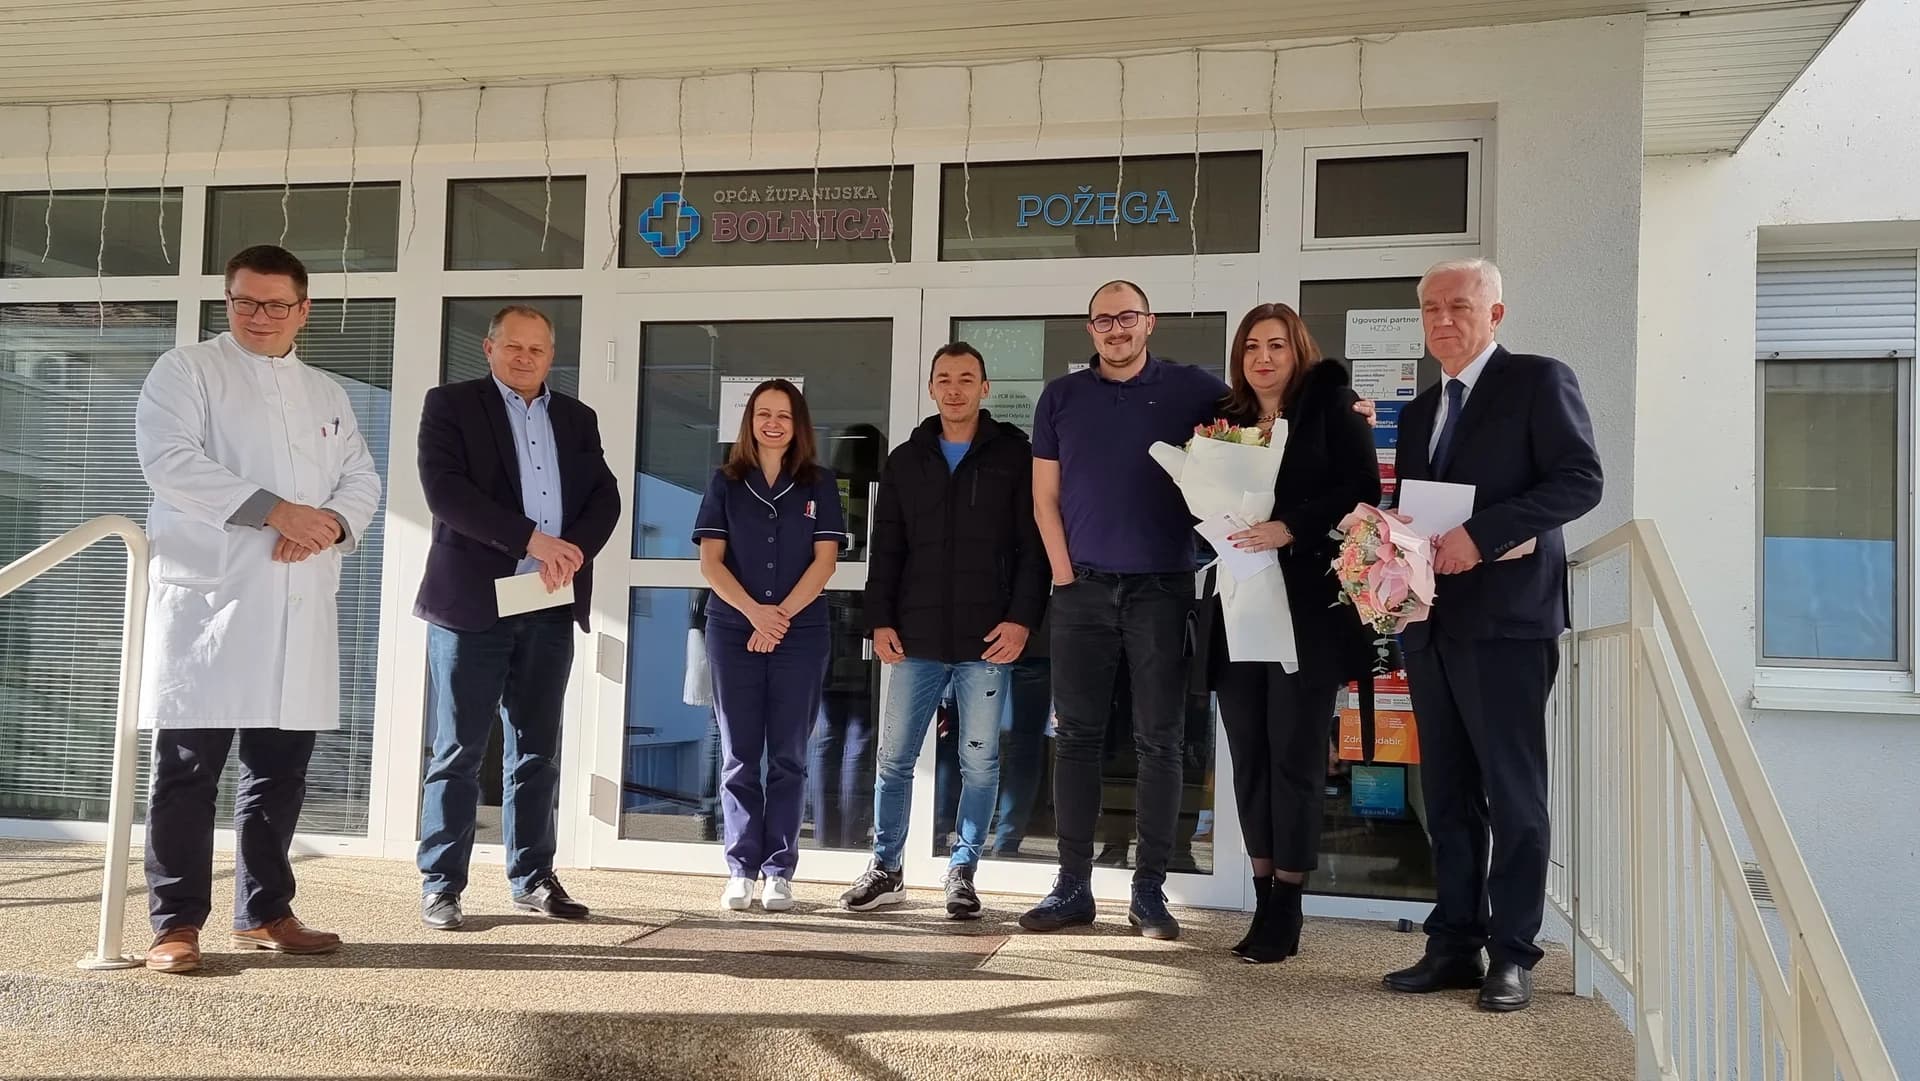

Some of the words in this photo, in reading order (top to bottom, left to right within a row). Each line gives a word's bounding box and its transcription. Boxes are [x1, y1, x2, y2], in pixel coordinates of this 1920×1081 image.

[713, 187, 761, 203] OPĆA
[765, 185, 878, 202] ŽUPANIJSKA
[1016, 185, 1180, 227] POŽEGA
[711, 208, 895, 242] BOLNICA
[1352, 316, 1388, 325] Ugovorni
[1390, 316, 1419, 325] partner
